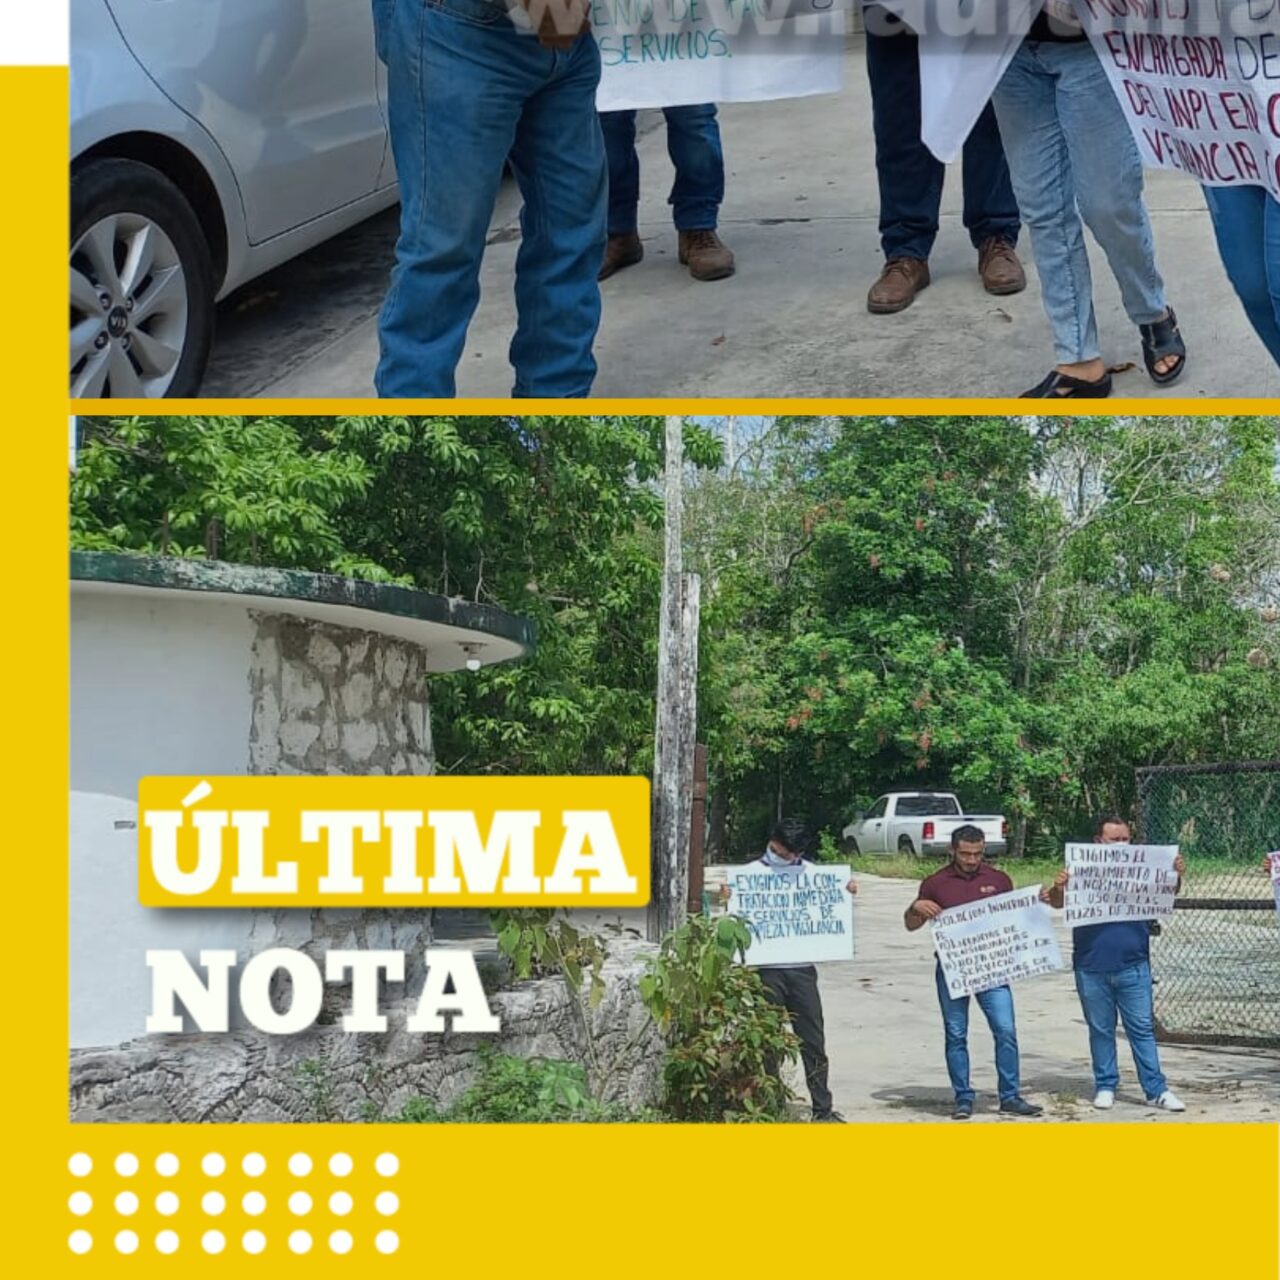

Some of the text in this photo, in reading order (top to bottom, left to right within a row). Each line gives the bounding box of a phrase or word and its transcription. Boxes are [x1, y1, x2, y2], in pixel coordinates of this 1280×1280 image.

[1105, 30, 1227, 80] ENCARGADA
[1235, 35, 1280, 81] DE
[1123, 79, 1161, 118] DEL
[1168, 88, 1218, 130] INPI
[1222, 92, 1257, 135] EN
